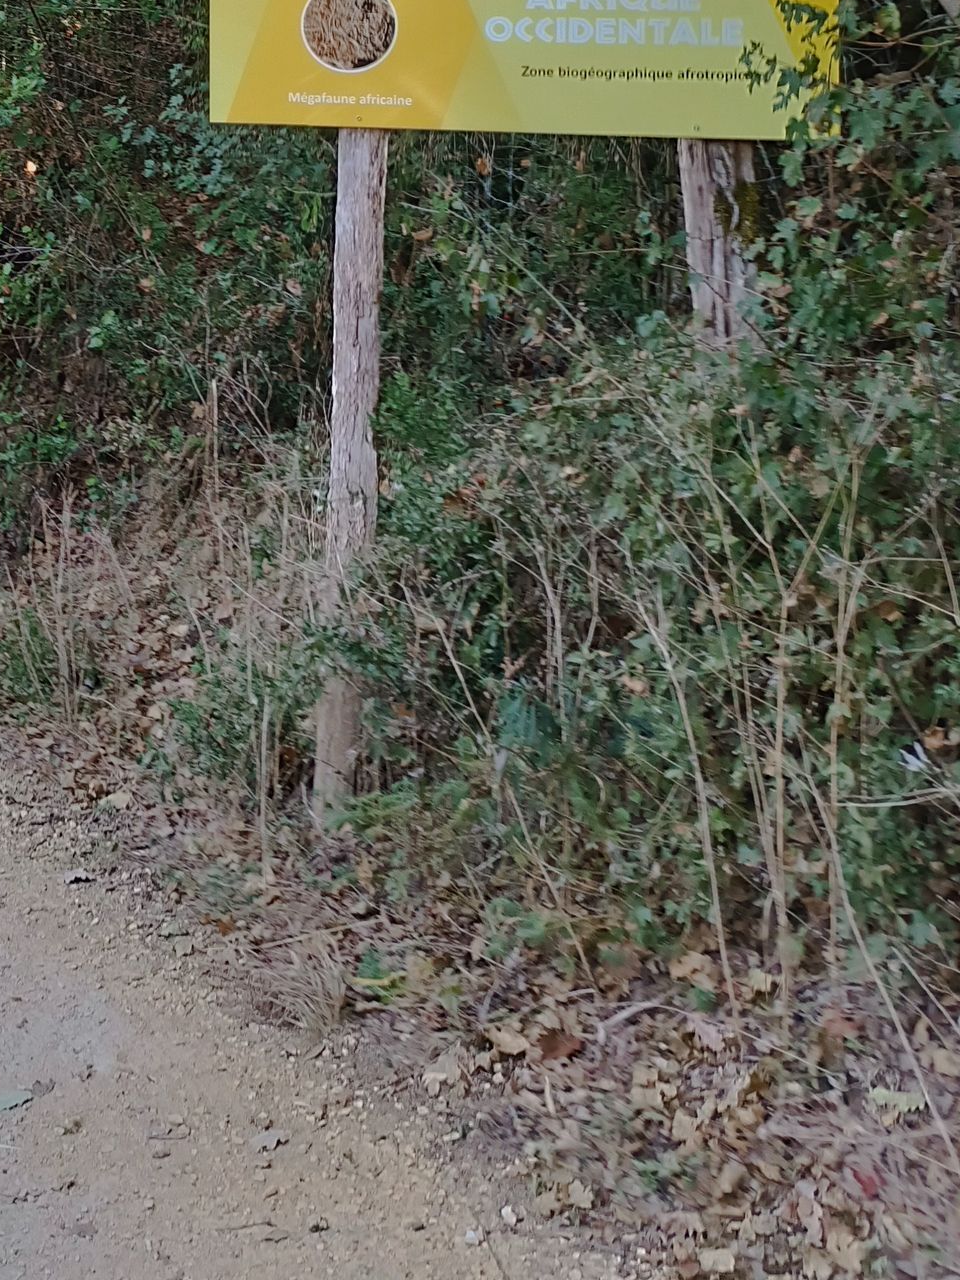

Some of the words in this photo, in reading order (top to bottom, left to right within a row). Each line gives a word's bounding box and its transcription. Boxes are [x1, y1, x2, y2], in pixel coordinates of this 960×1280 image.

[484, 15, 745, 47] OCCIDENTALE
[520, 65, 554, 78] Zone
[558, 66, 673, 82] biogéographique
[677, 67, 762, 84] afrotropic
[287, 91, 356, 105] Mégafaune
[359, 93, 413, 106] africaine
